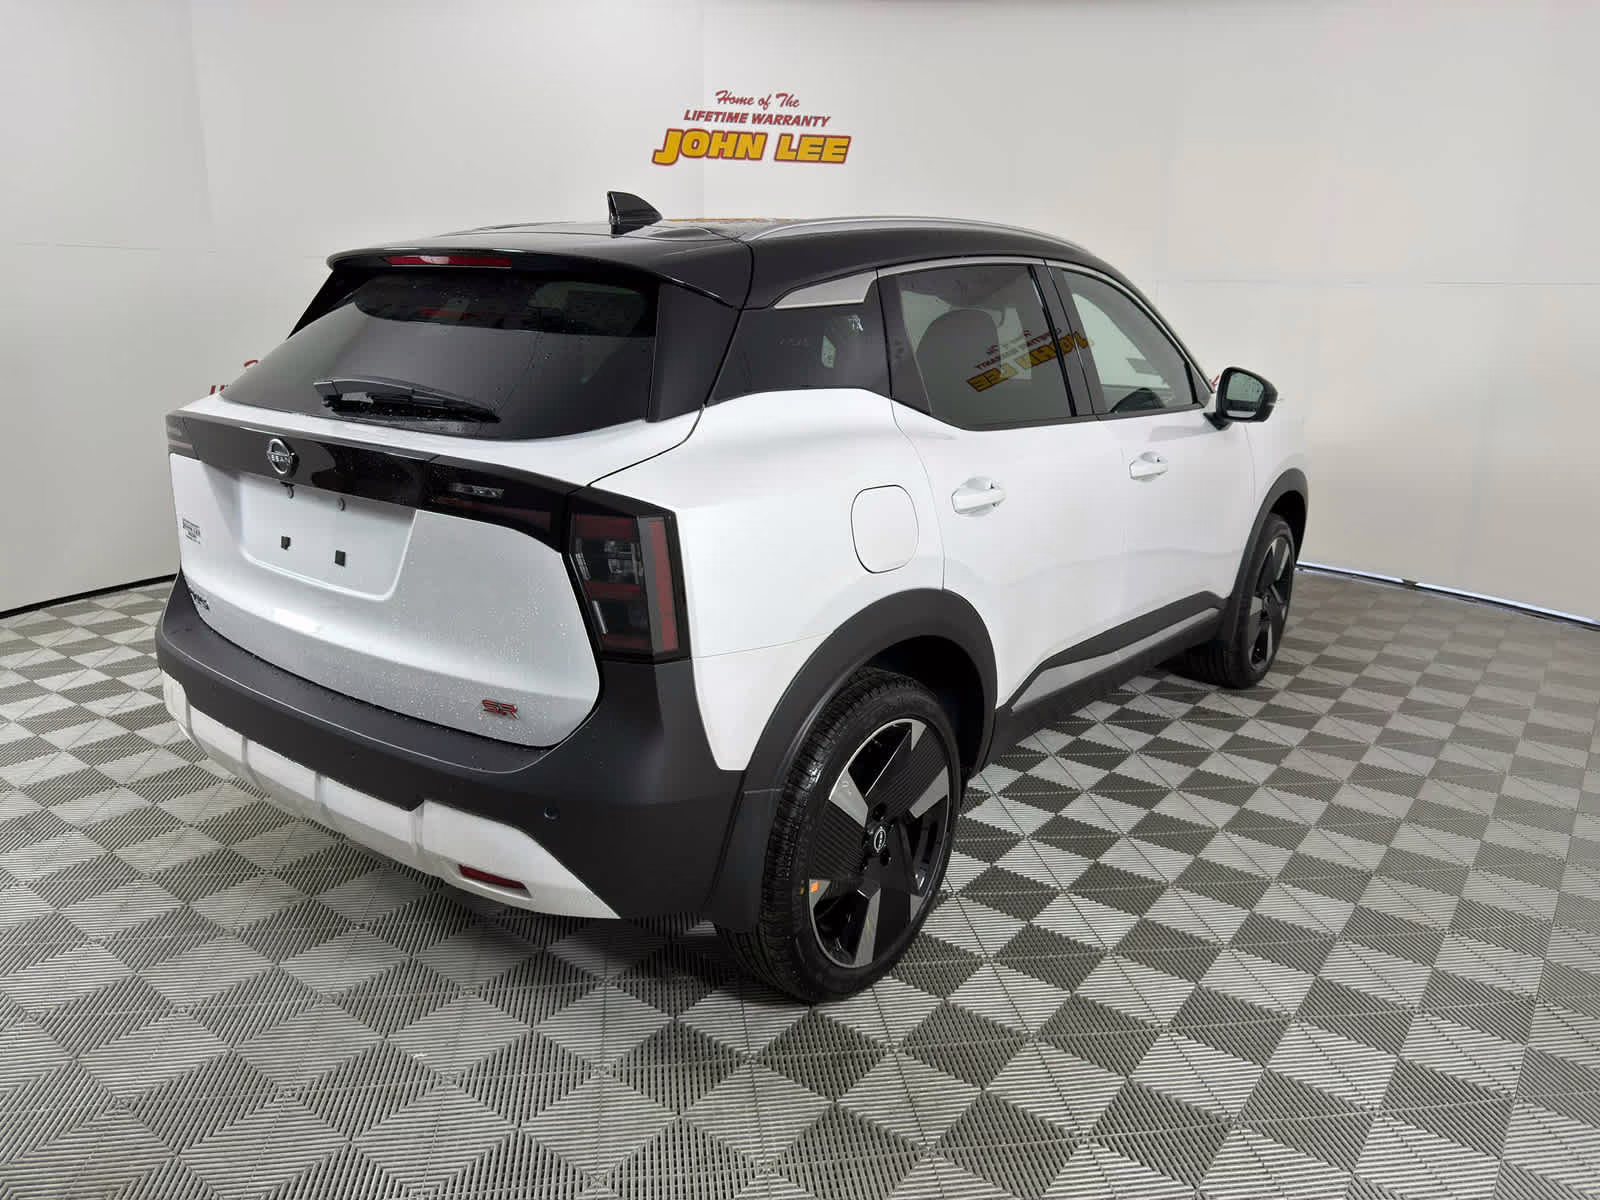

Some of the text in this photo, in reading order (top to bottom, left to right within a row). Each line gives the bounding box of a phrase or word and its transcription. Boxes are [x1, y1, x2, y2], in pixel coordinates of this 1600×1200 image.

[715, 90, 800, 110] Home of The
[683, 109, 831, 127] LIFETIME WARRANTY
[652, 128, 852, 165] JOHN LEE
[482, 699, 520, 720] SR
